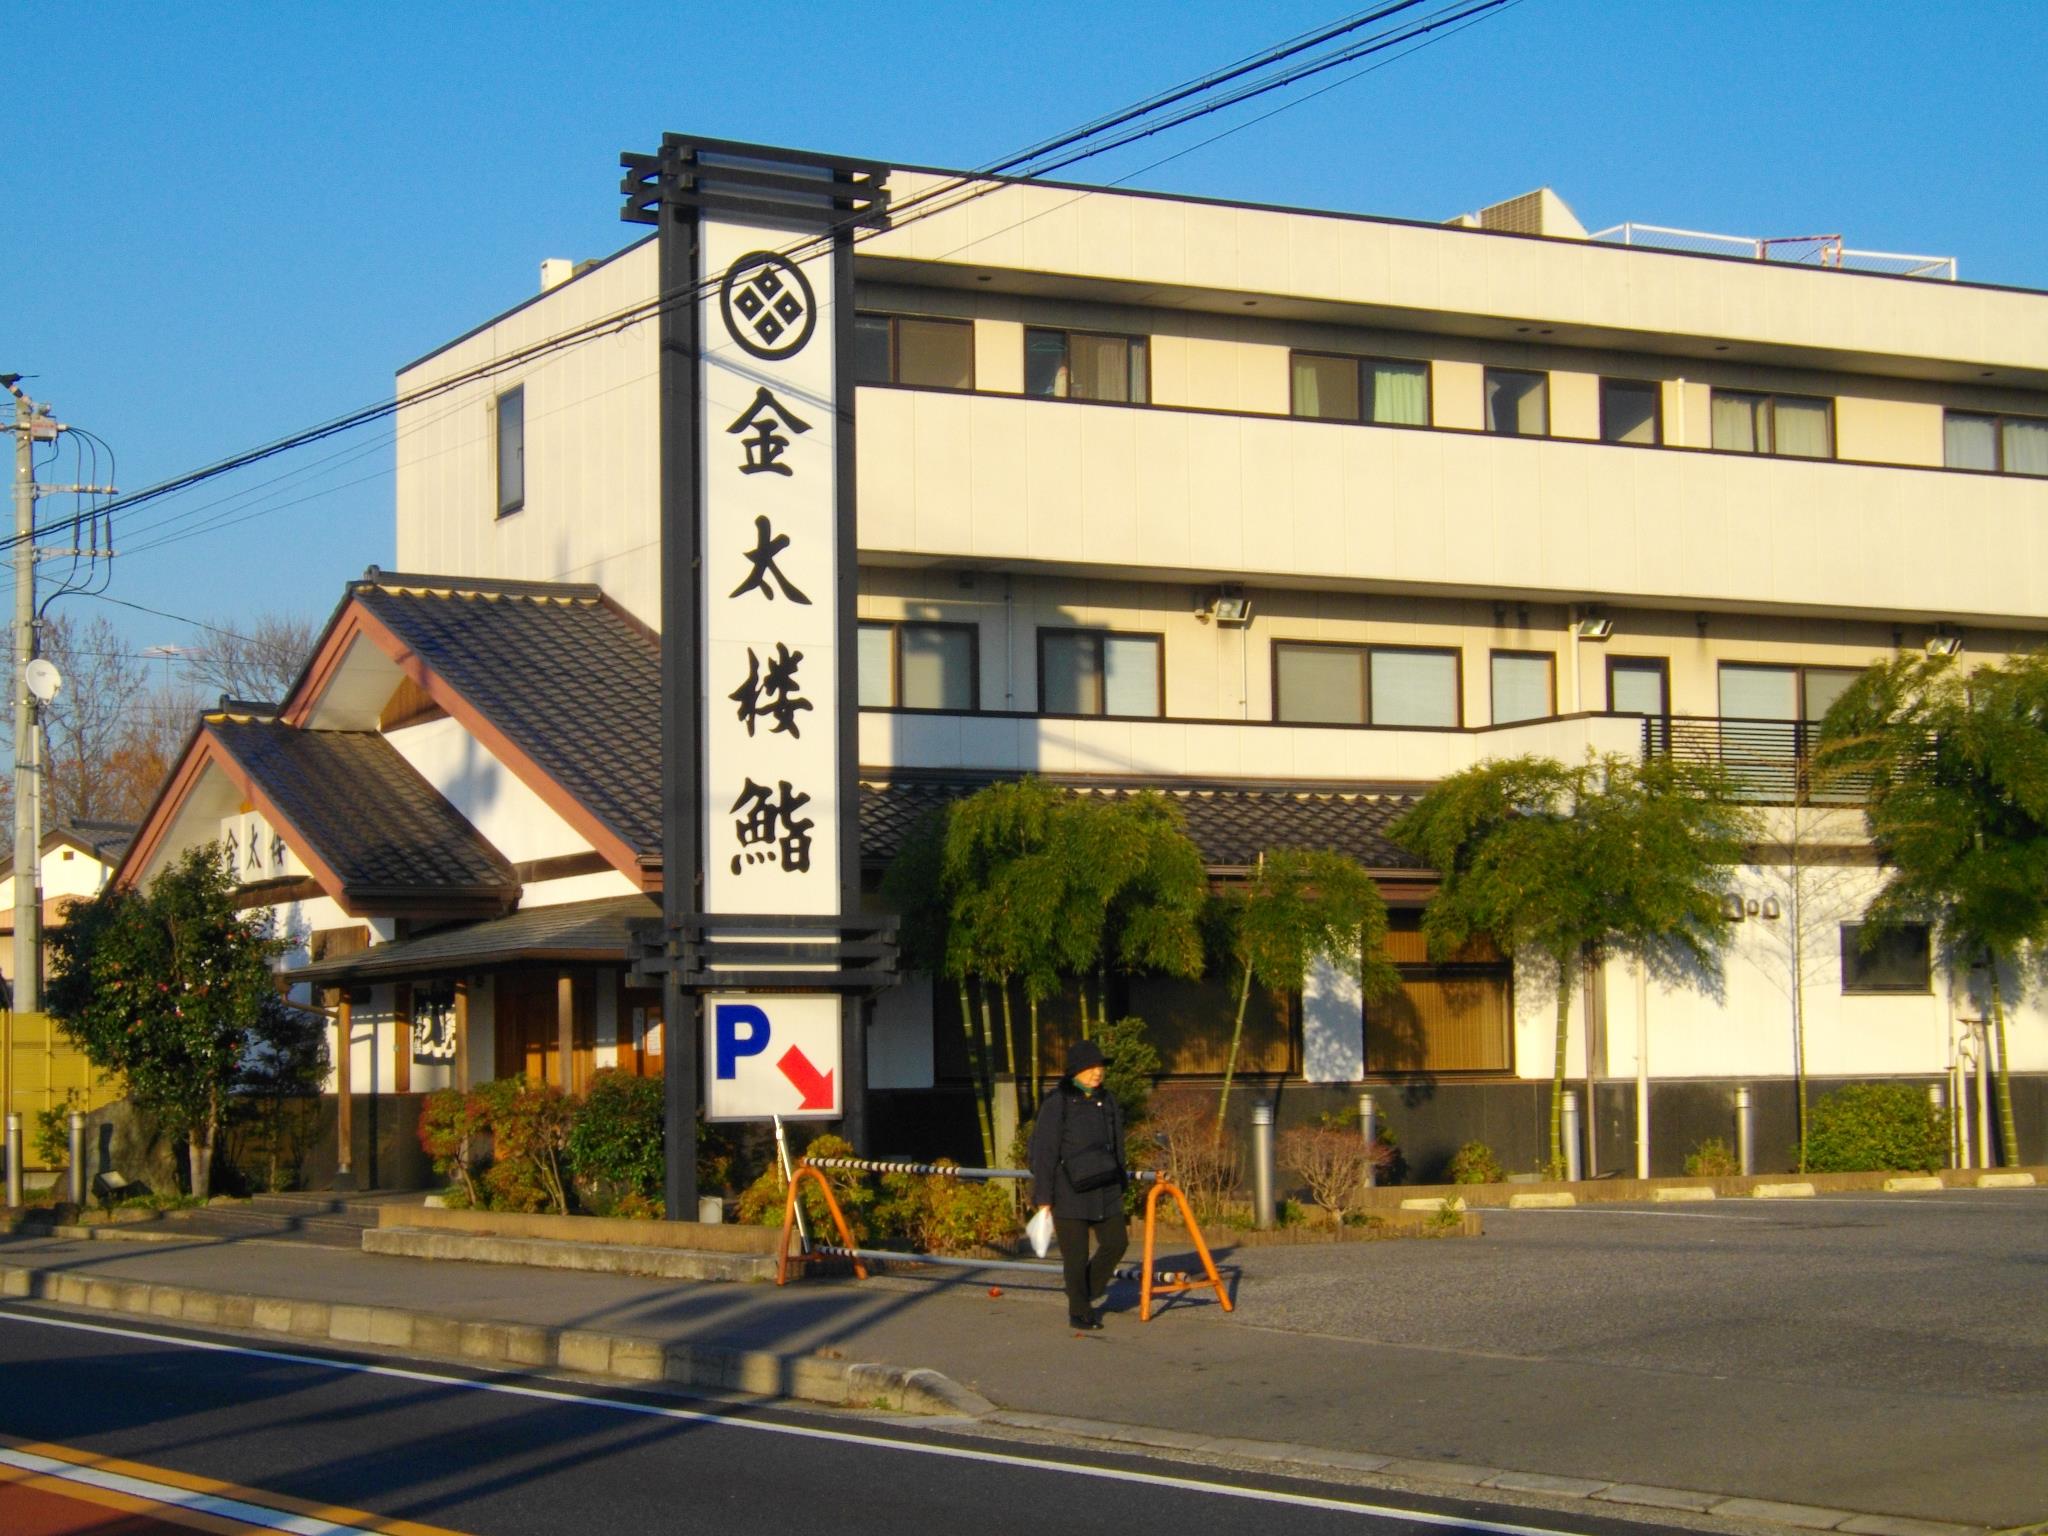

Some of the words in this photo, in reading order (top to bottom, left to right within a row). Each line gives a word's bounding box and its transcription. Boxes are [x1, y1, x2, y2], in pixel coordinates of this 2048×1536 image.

[728, 387, 814, 875] 金太楼鮨
[716, 1005, 770, 1079] P
